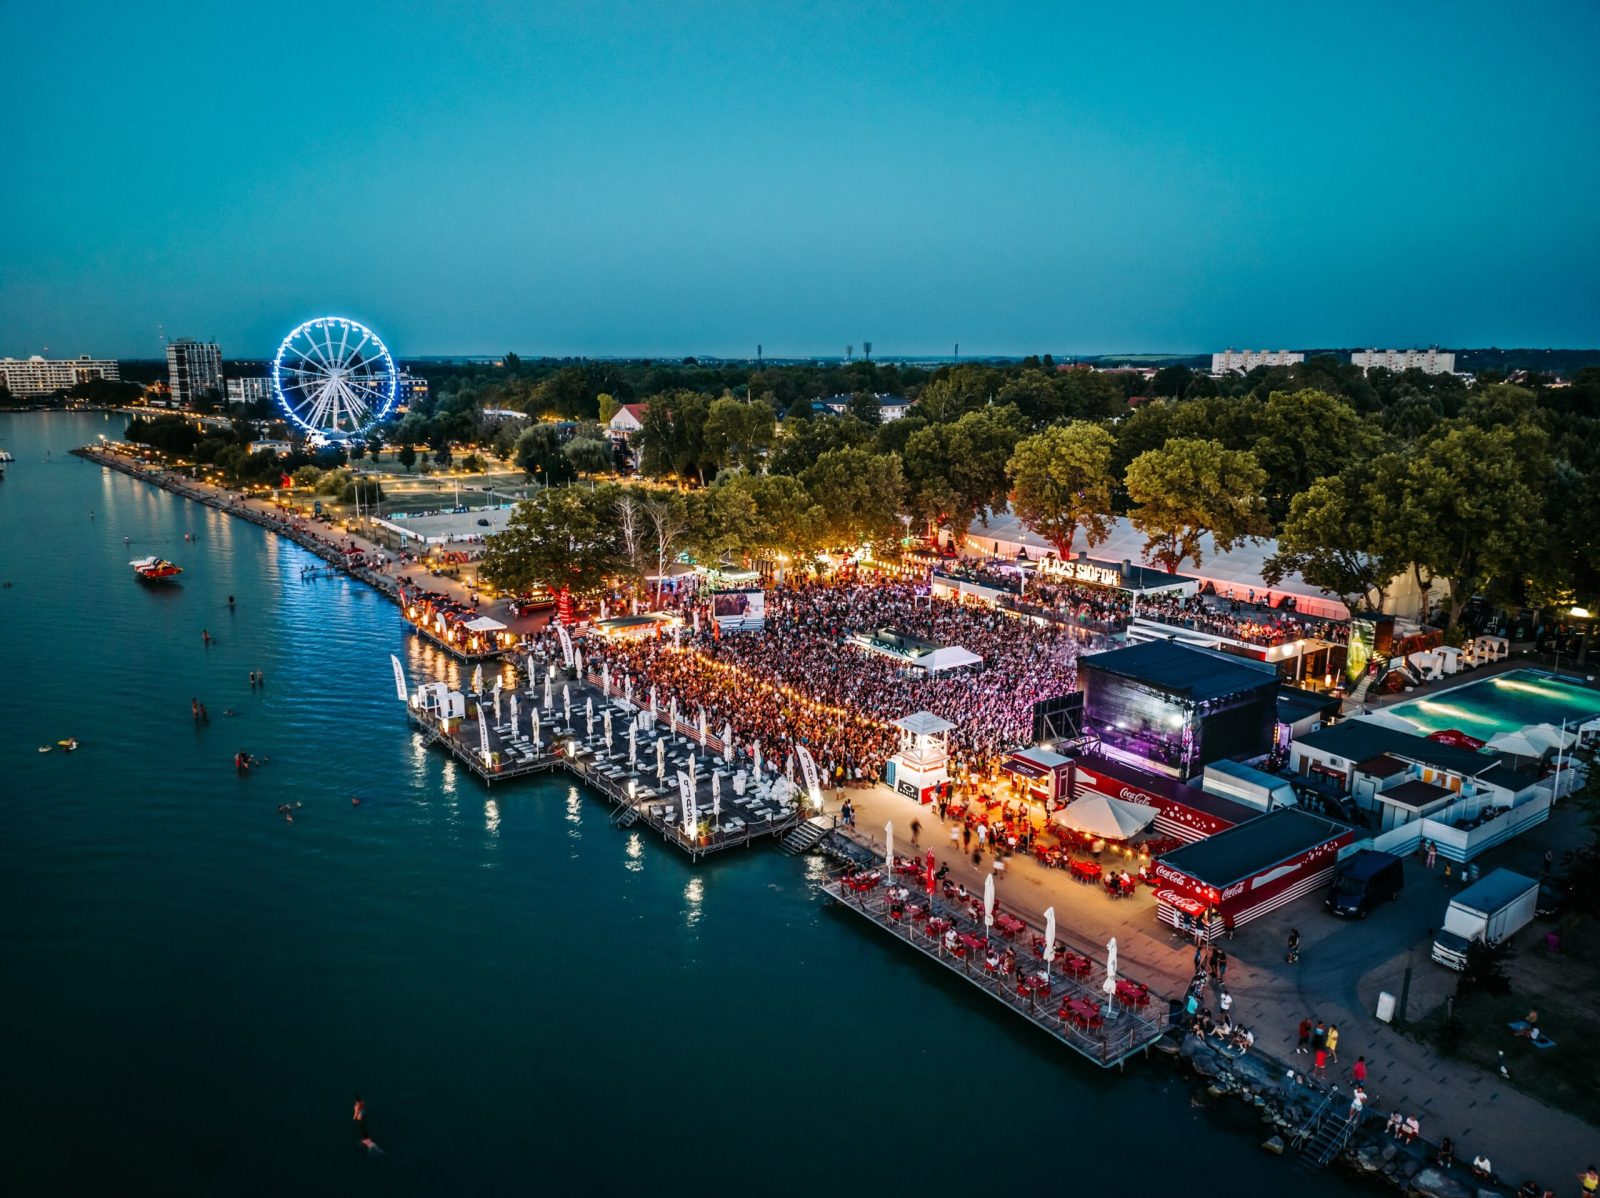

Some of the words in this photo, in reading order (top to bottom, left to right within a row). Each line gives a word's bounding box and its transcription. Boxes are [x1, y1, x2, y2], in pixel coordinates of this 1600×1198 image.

[1076, 563, 1119, 586] SIÓFOK
[1120, 787, 1152, 806] Coca-Cola
[1156, 865, 1186, 886] Coca-Cola
[1157, 889, 1204, 912] Coca-Cola
[1222, 881, 1246, 901] Coca-Cola
